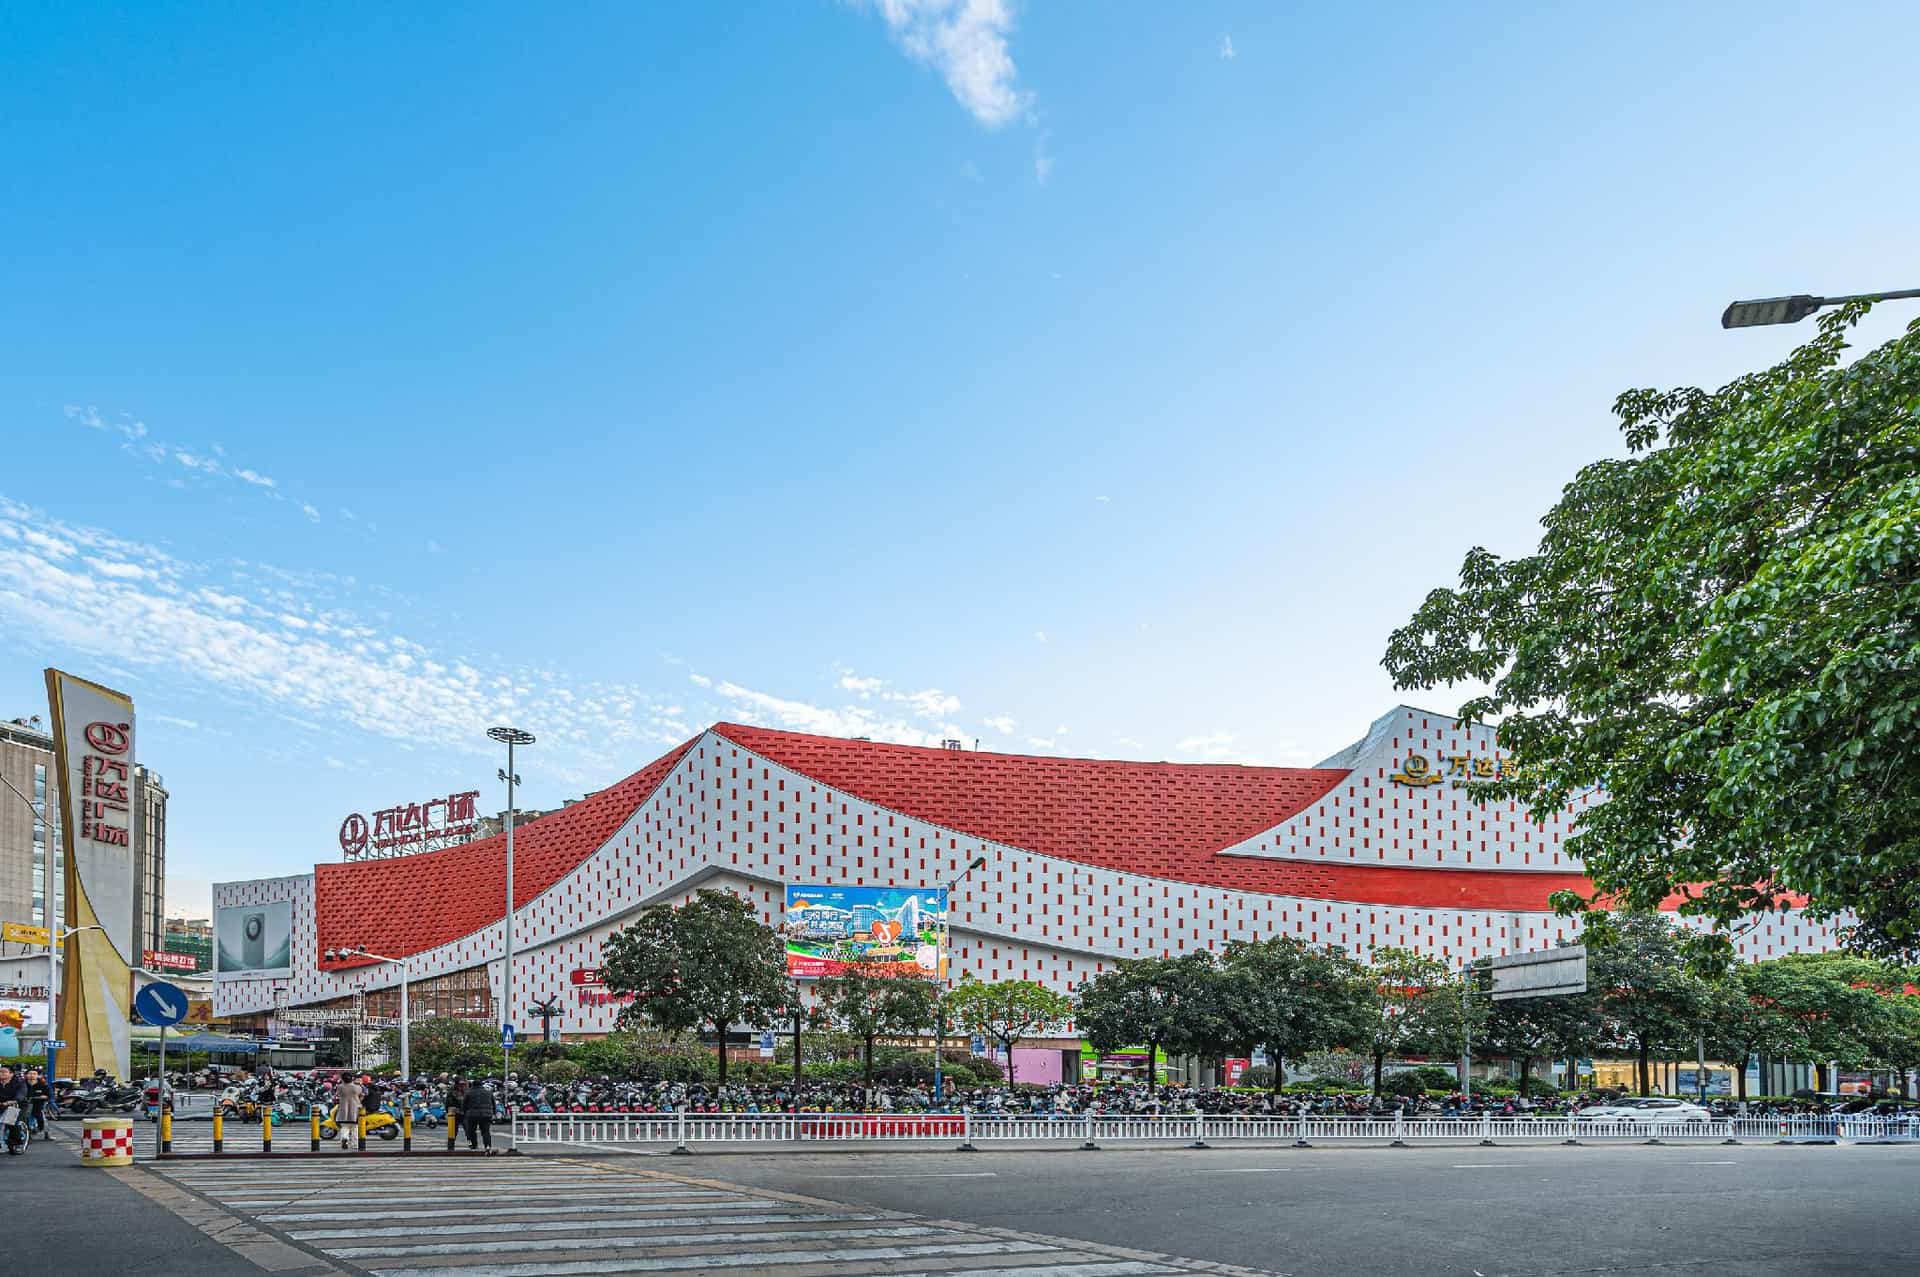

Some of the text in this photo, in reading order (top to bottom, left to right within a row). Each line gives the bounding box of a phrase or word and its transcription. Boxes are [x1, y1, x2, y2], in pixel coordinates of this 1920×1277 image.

[95, 756, 129, 847] 万达广场
[372, 791, 475, 836] 万达广场
